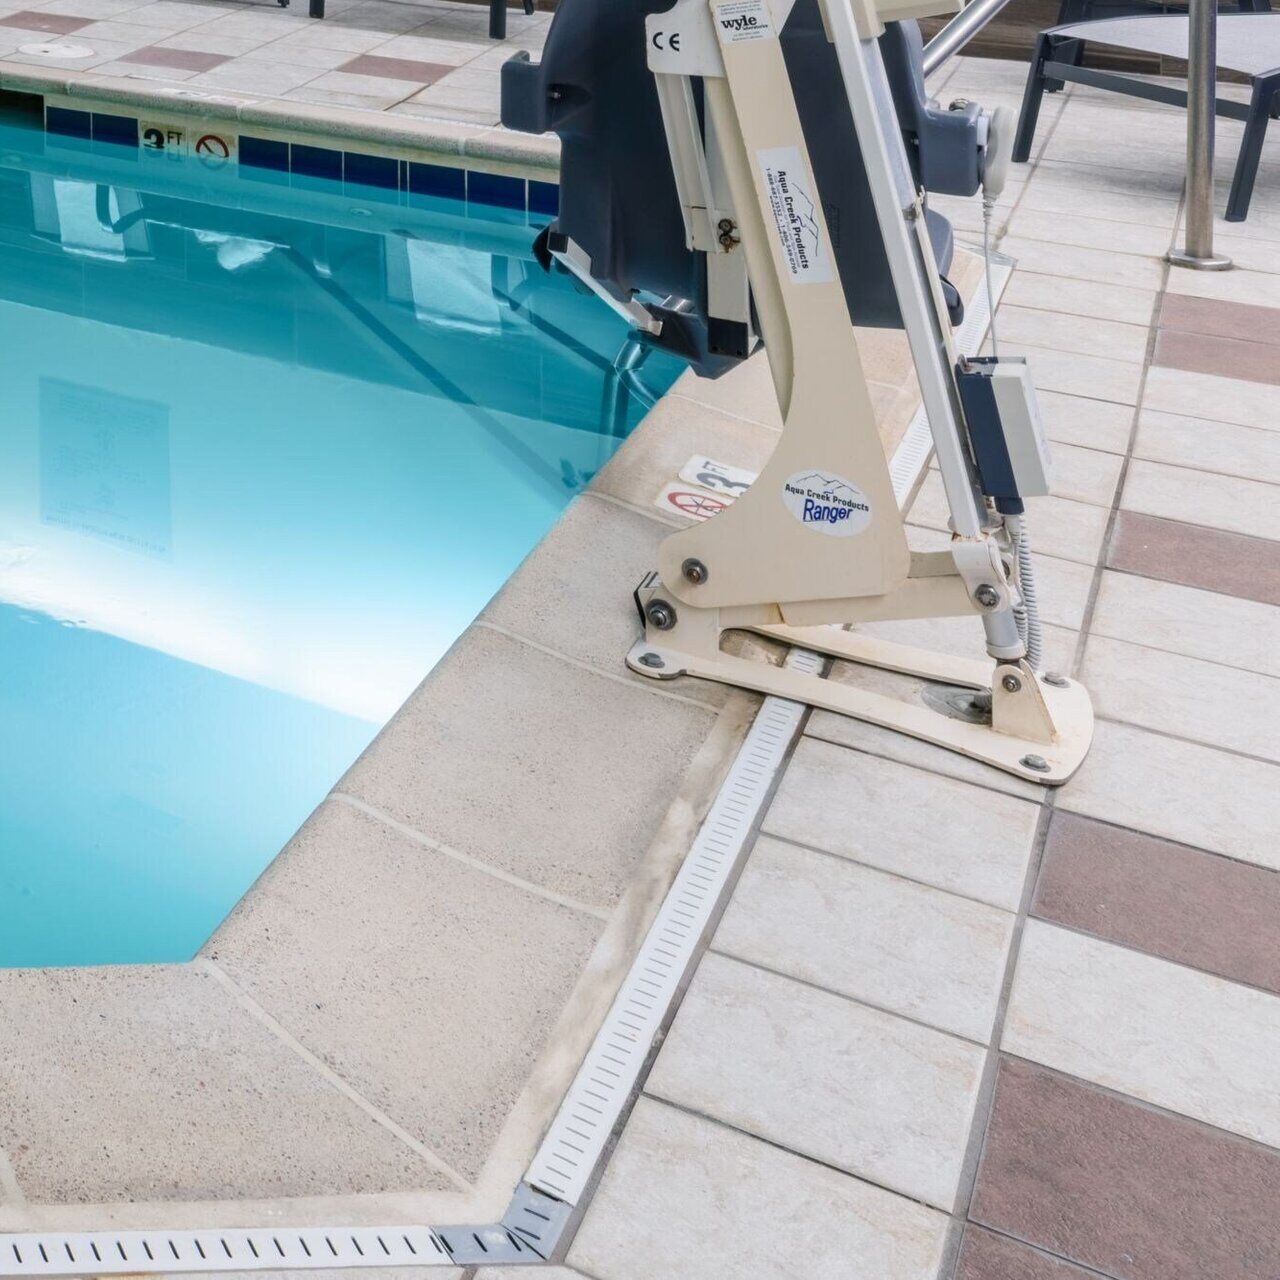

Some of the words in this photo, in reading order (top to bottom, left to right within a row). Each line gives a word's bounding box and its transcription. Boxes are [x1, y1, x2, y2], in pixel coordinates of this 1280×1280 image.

[720, 14, 758, 31] wyle
[167, 131, 182, 145] FT
[777, 170, 789, 194] Aqua
[784, 196, 798, 224] Creek
[792, 226, 809, 269] Products
[785, 483, 805, 495] Aqua
[807, 489, 831, 502] Creek
[832, 495, 869, 512] Products
[803, 498, 854, 524] Ranger
